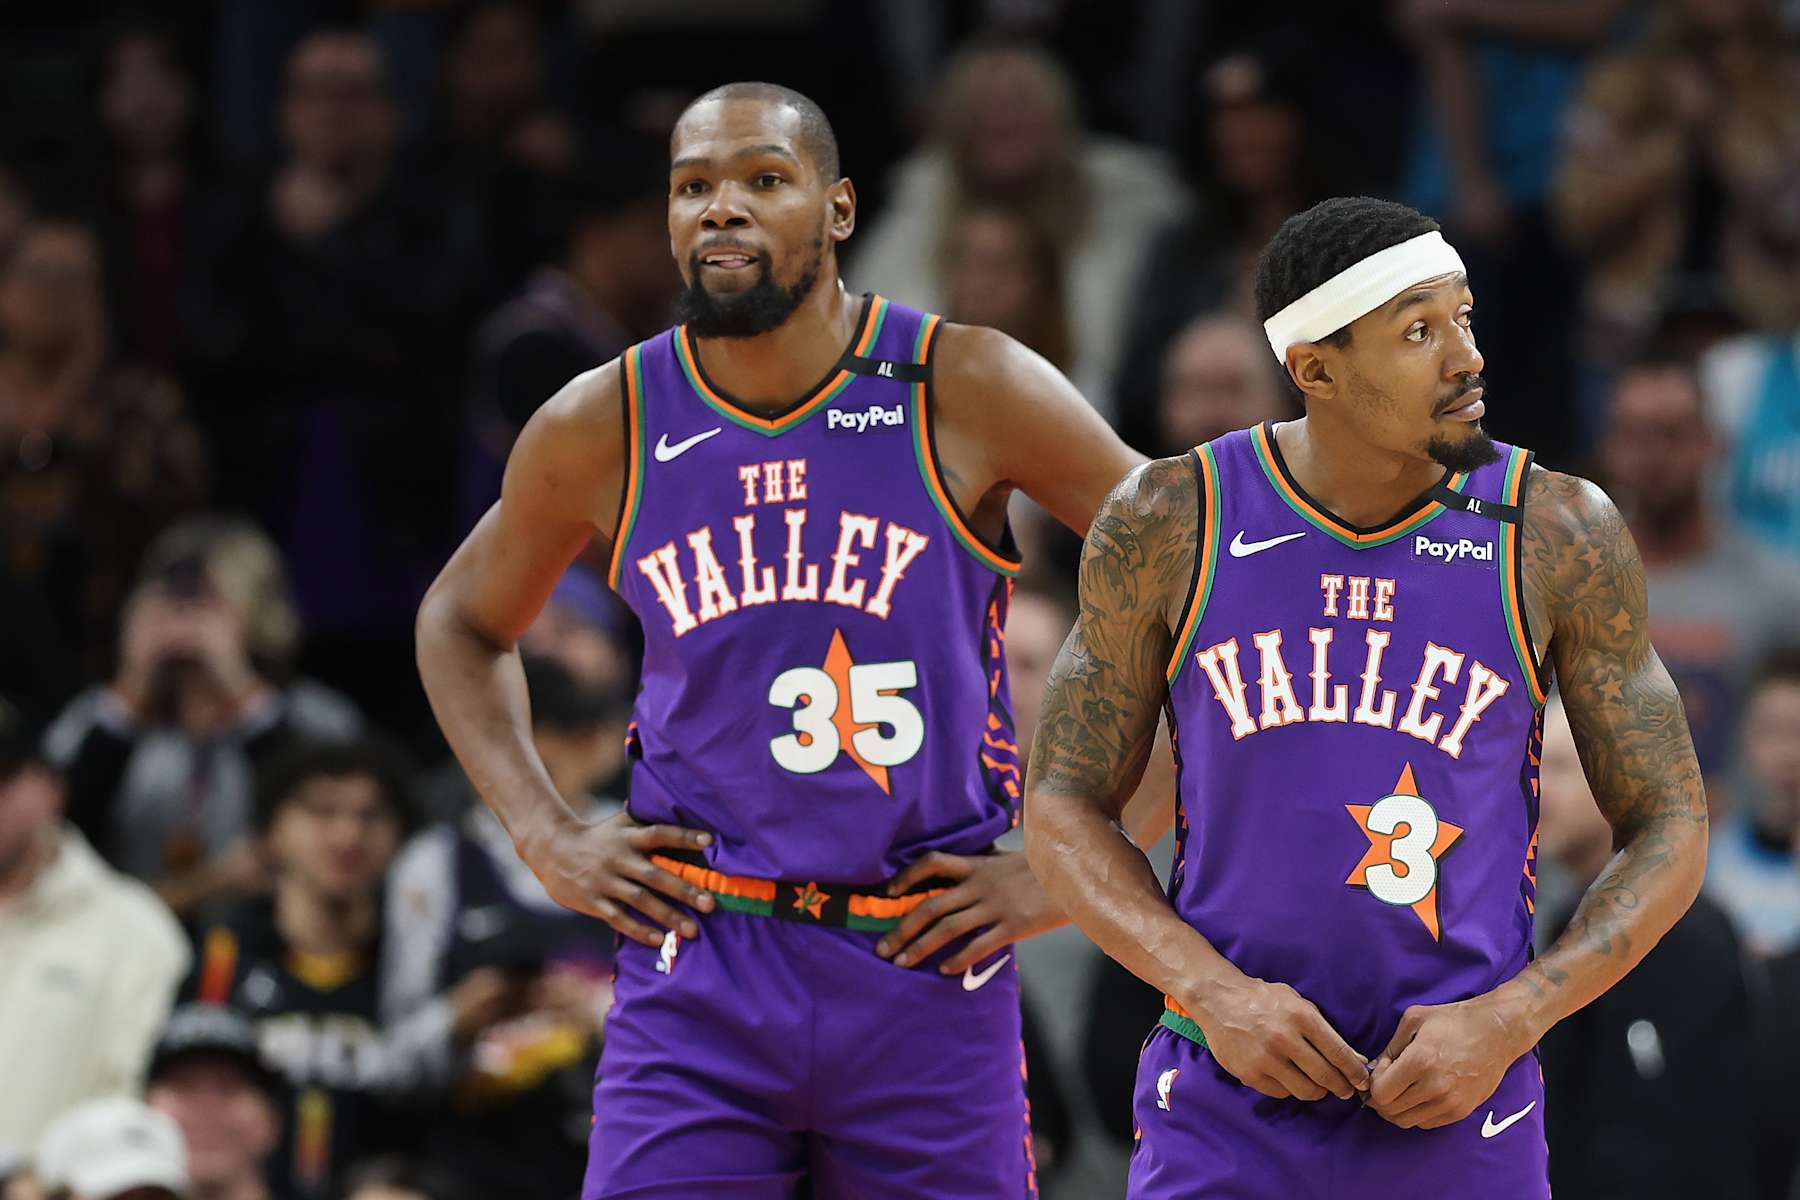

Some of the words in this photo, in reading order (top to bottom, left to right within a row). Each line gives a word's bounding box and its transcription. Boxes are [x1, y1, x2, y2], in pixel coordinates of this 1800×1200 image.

[877, 362, 894, 377] AL
[827, 404, 904, 432] PayPal
[738, 458, 808, 506] THE
[1466, 498, 1482, 514] AL
[1414, 535, 1493, 562] PayPal
[636, 508, 929, 638] VALLEY
[1321, 574, 1396, 621] THE
[767, 660, 925, 774] 35
[1195, 627, 1510, 760] VALLEY
[1365, 794, 1438, 905] 3
